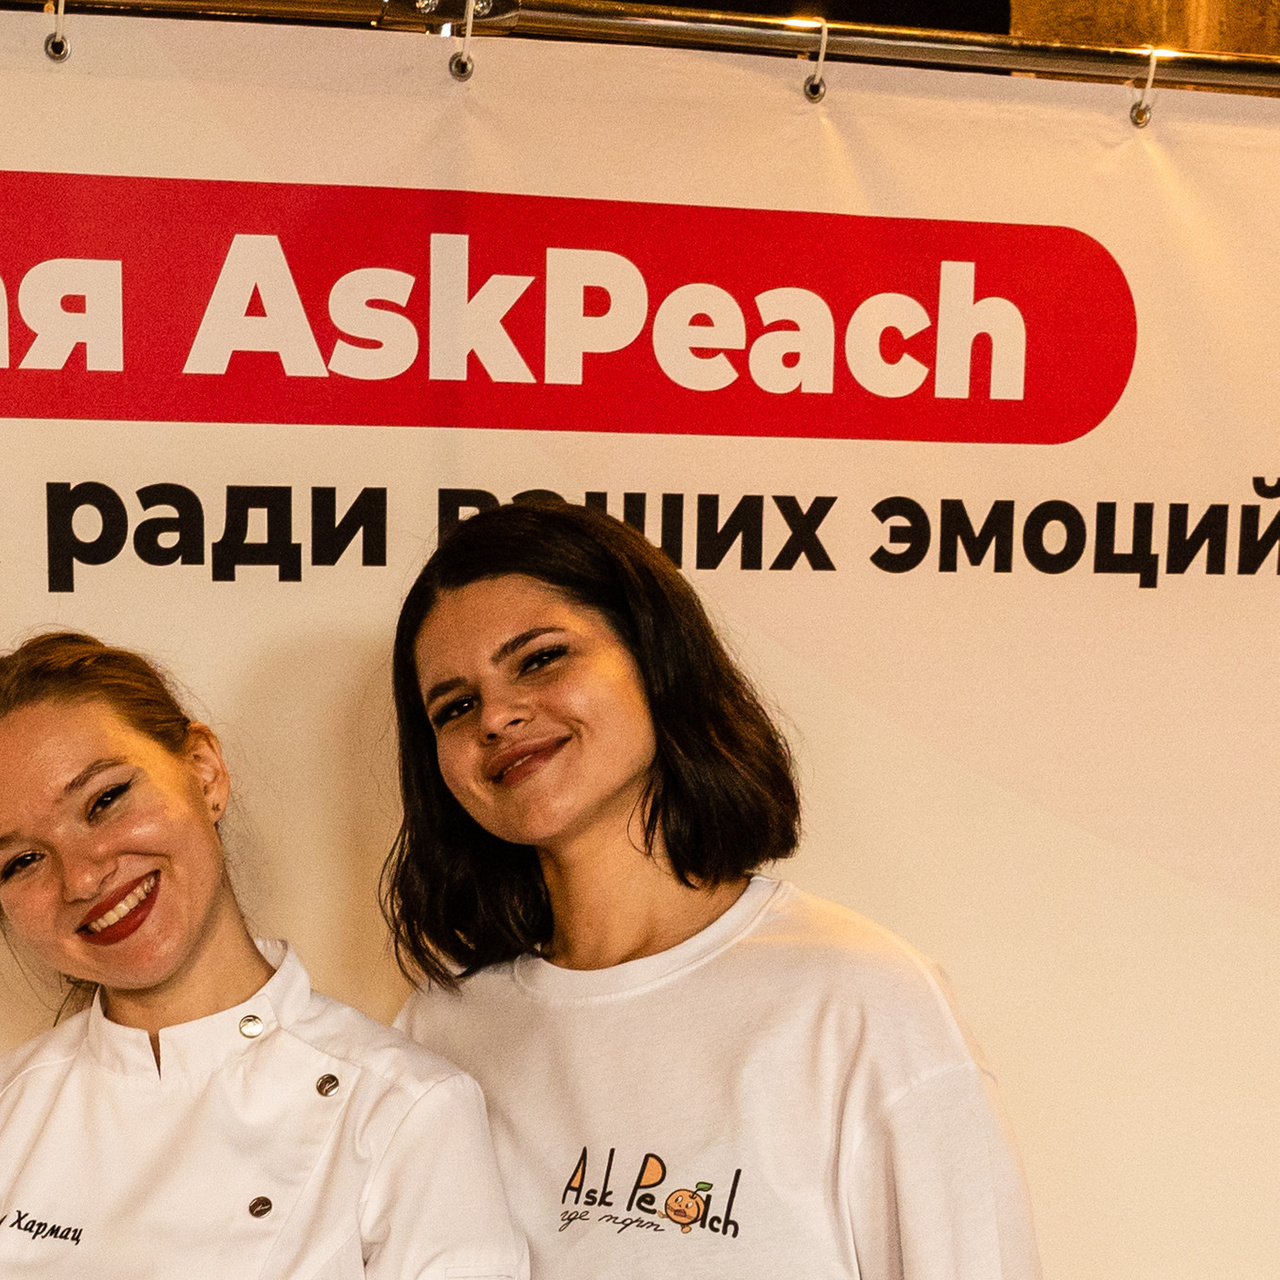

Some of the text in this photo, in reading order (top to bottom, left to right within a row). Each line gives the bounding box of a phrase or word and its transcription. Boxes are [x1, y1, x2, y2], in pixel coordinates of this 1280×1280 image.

[182, 232, 1027, 401] AskPeach
[46, 481, 388, 592] ради
[561, 1146, 616, 1207] Ask
[8, 1209, 84, 1246] Хармац
